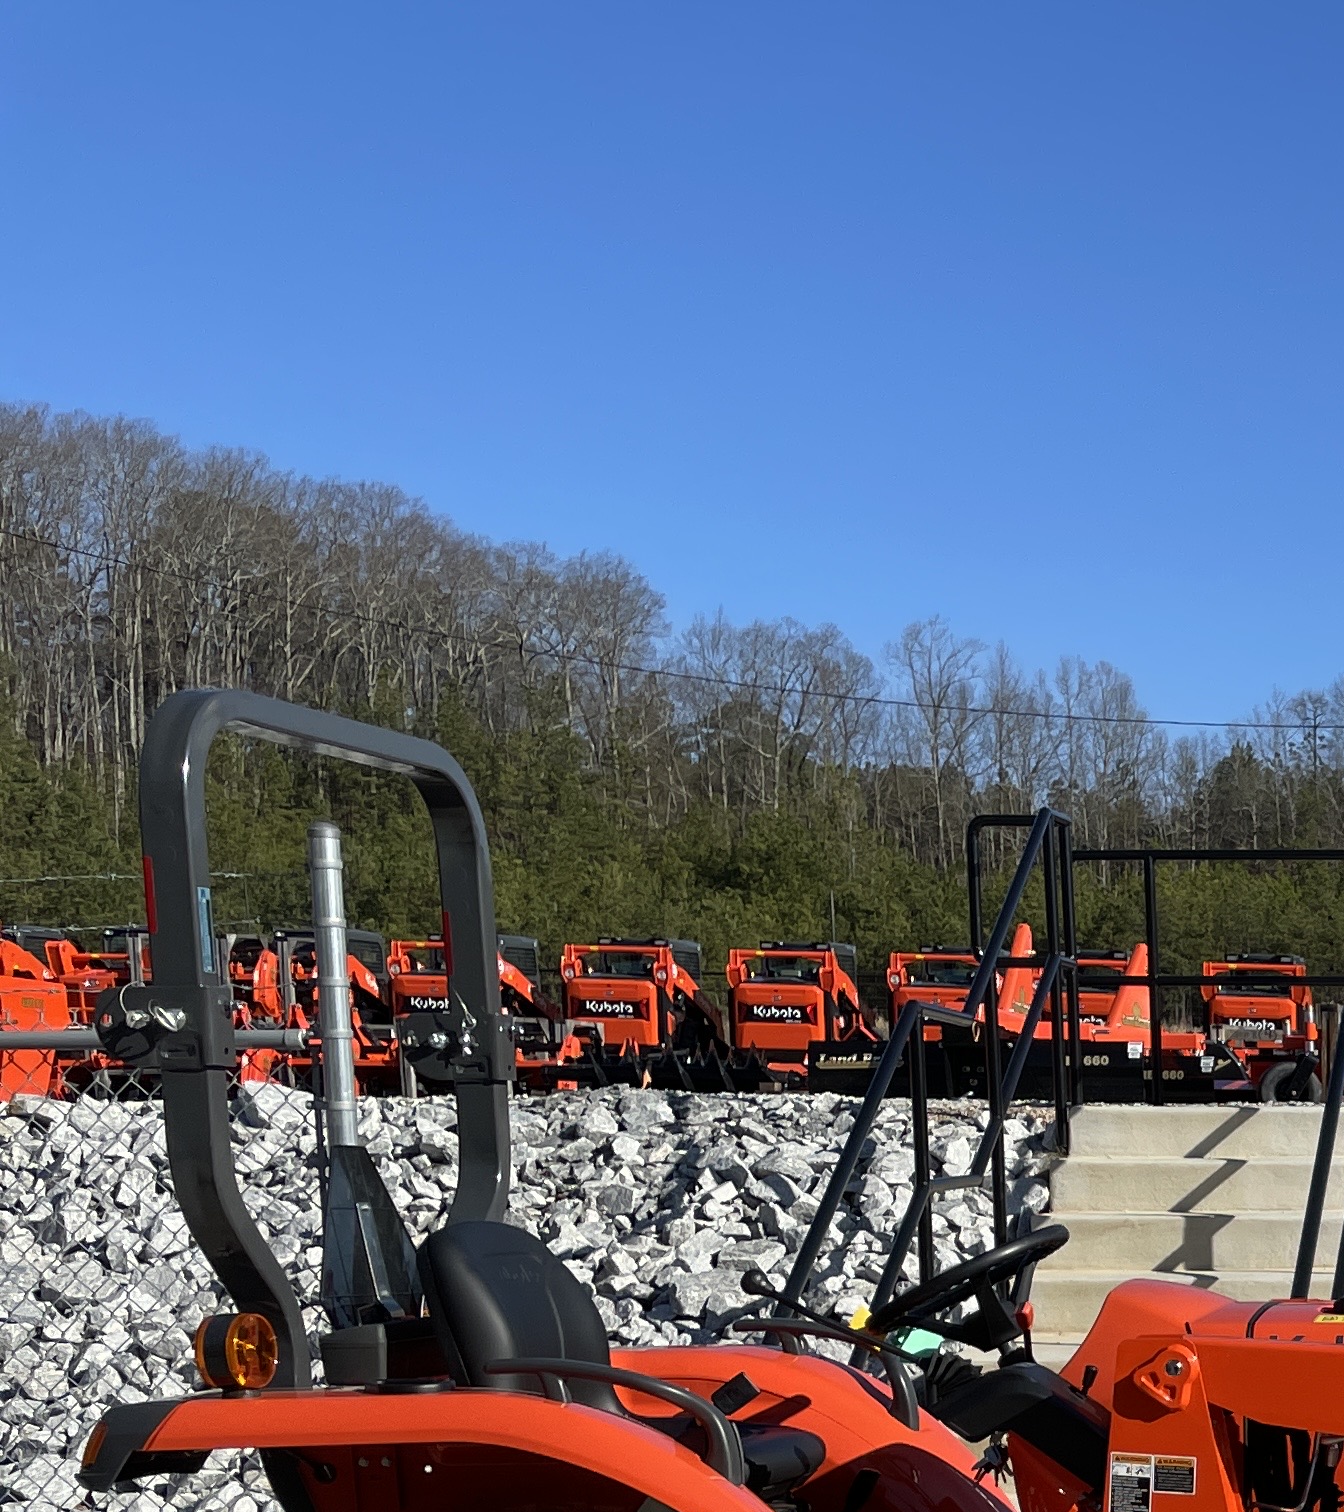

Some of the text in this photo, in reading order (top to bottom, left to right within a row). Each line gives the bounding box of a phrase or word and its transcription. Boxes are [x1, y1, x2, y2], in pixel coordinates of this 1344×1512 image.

[410, 996, 450, 1009] Kubot
[585, 1000, 634, 1013] Kubota
[753, 1005, 801, 1018] Kubota
